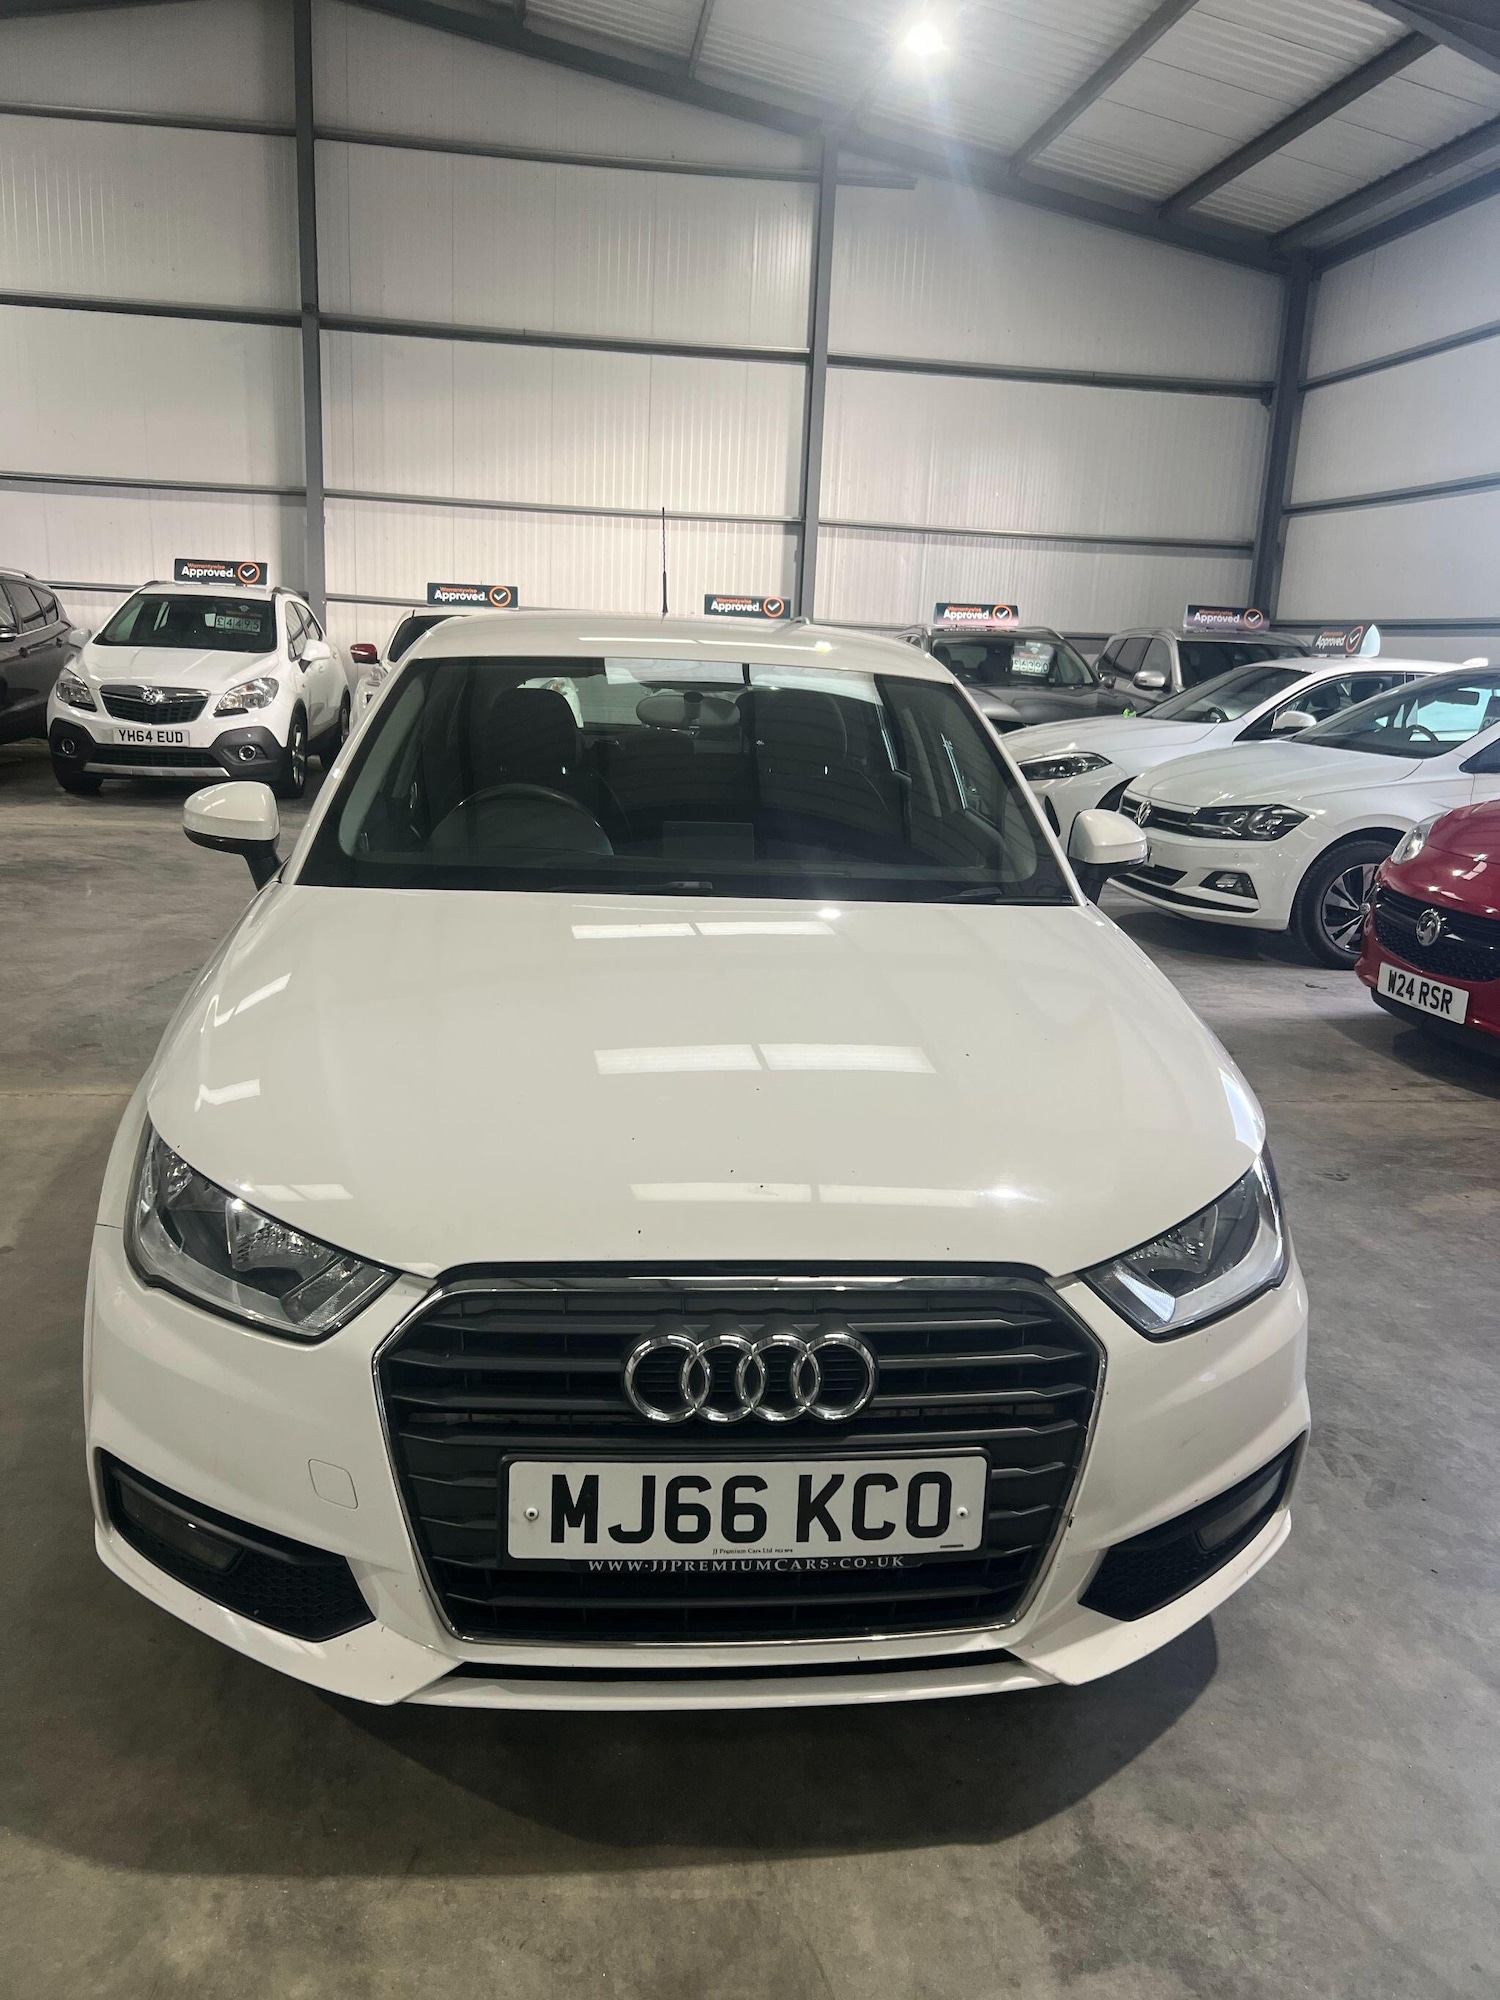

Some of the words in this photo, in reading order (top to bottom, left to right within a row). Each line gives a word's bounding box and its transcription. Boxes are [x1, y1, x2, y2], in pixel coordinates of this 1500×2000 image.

[181, 566, 236, 578] Approved.
[434, 590, 488, 602] Approved.
[711, 600, 762, 613] Approved.
[119, 729, 153, 742] YH64
[157, 731, 183, 743] EUD
[1387, 969, 1414, 1001] W24
[1418, 981, 1453, 1014] RSR
[550, 1474, 768, 1544] MJ66
[796, 1471, 952, 1542] KCO
